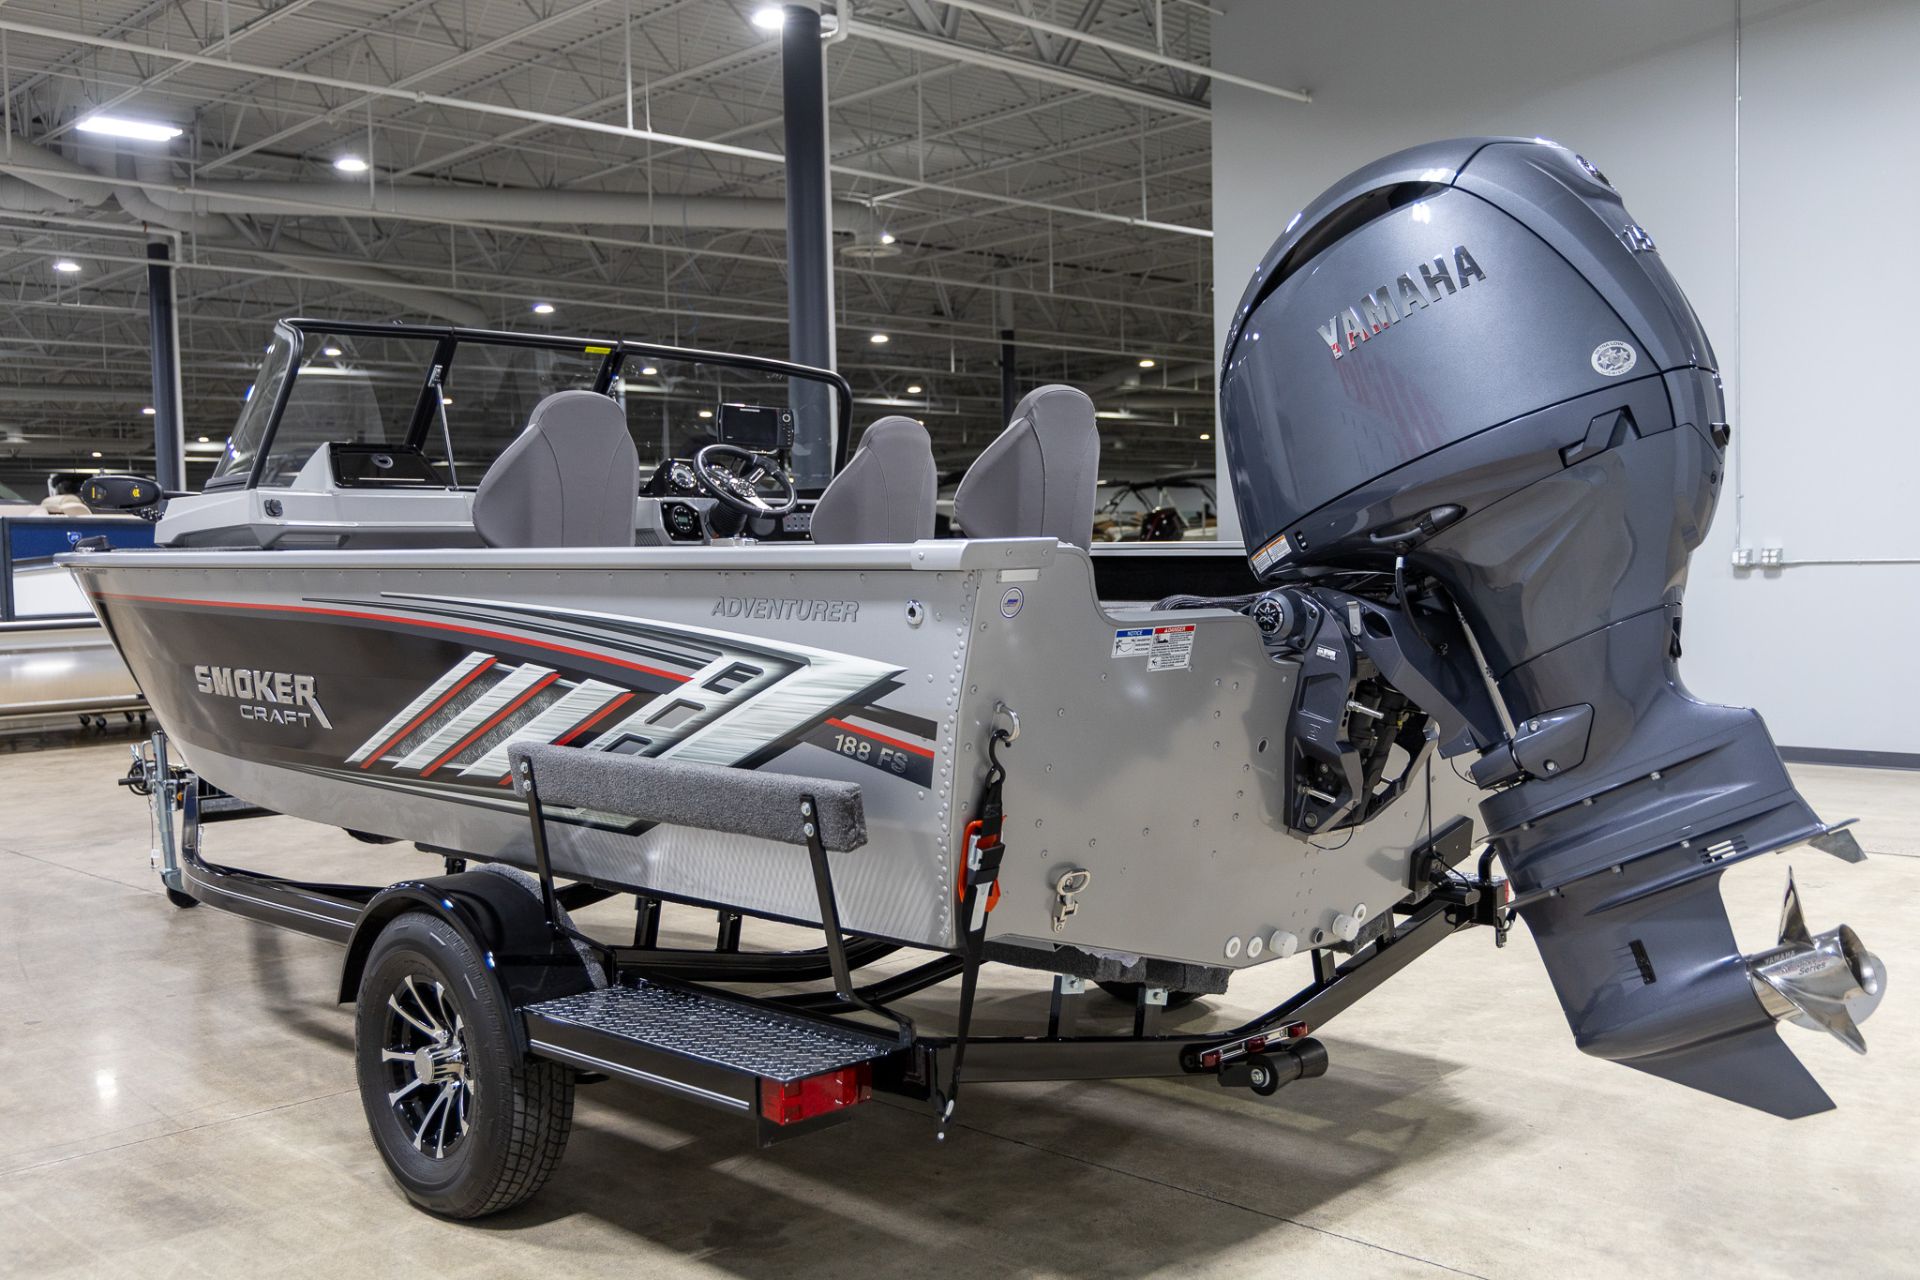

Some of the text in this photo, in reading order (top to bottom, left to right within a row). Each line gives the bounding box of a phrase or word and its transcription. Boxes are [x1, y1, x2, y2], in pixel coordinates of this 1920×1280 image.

[1316, 245, 1487, 360] YAMAHA
[711, 595, 860, 623] ADVENTURER
[194, 665, 333, 730] SMOKER
[239, 704, 312, 728] CRAFT
[834, 734, 909, 774] 188 FS
